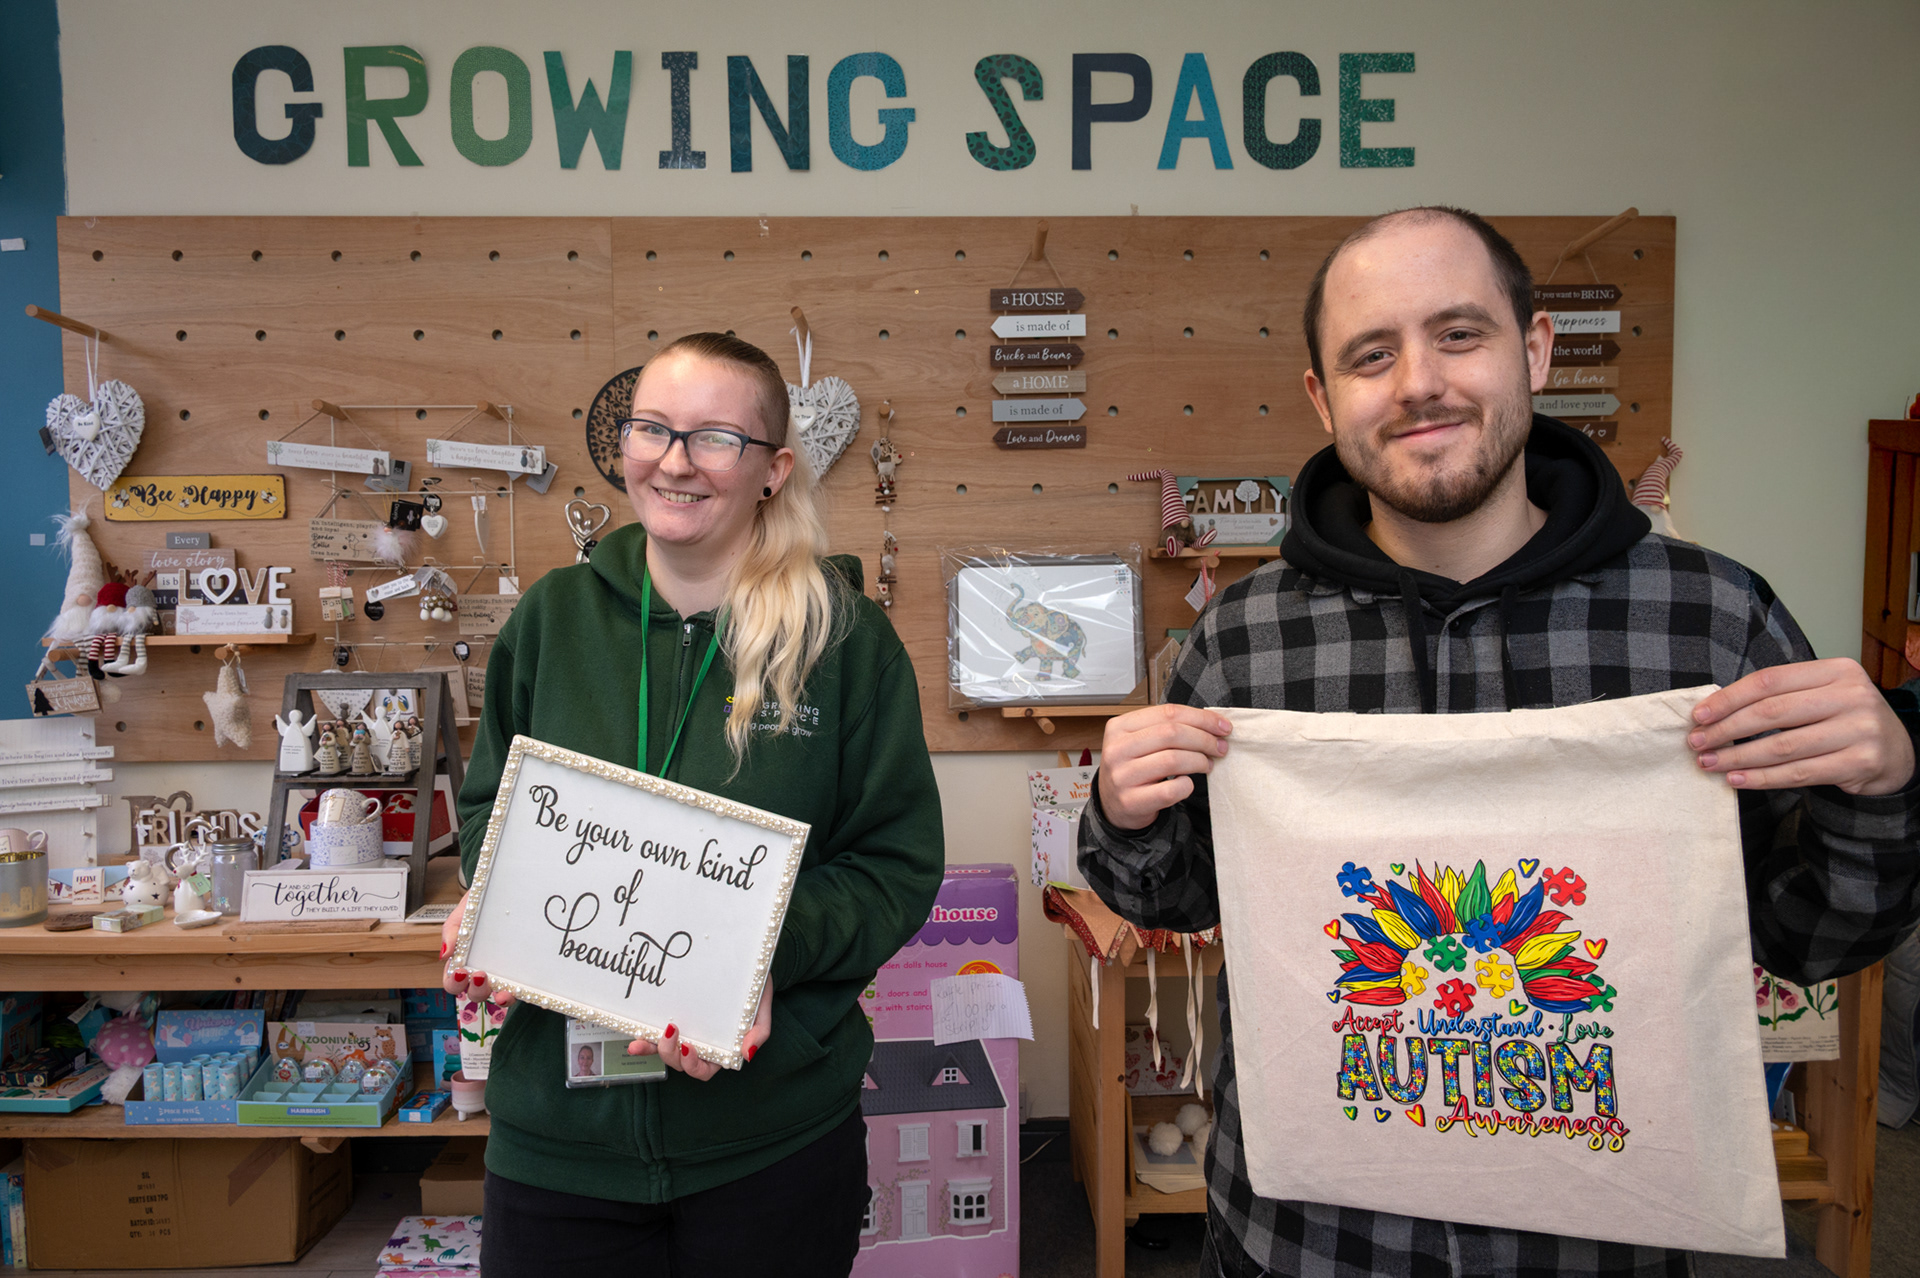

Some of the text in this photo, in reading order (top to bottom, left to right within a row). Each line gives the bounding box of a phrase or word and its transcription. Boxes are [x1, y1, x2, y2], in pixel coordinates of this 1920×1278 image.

[232, 44, 1416, 172] GROWING SPACE
[1002, 292, 1065, 306] a HOUSE
[1534, 291, 1541, 299] If
[1542, 293, 1555, 301] you
[1556, 291, 1572, 299] want
[1581, 290, 1614, 299] BRING
[1016, 320, 1070, 332] is made of
[995, 348, 1025, 361] Bricks
[1042, 347, 1072, 361] Beams
[1553, 345, 1602, 356] the world
[1013, 375, 1069, 389] a HOME
[1553, 369, 1606, 387] Go home
[1009, 404, 1063, 416] is made of
[1539, 399, 1607, 411] and love your
[1006, 429, 1081, 445] Love and Dreams
[129, 483, 258, 510] Bee Happy
[174, 536, 200, 546] Every
[311, 532, 335, 541] Border
[151, 550, 227, 570] love story
[162, 576, 171, 586] is
[792, 726, 812, 738] grow
[2, 778, 18, 786] lives
[529, 784, 768, 891] Be your own kind
[613, 869, 645, 927] of
[932, 905, 998, 922] house
[543, 892, 693, 999] beautiful
[904, 961, 922, 969] dolls
[925, 960, 948, 969] house
[887, 989, 910, 998] doors
[913, 988, 928, 997] and
[885, 1004, 904, 1012] with
[985, 1002, 996, 1018] for
[184, 1017, 237, 1031] Unicorn
[1332, 1004, 1614, 1044] Accept Understand Love
[305, 1036, 371, 1045] ZOONIVERSE
[1336, 1034, 1619, 1118] AUTISM
[1435, 1094, 1631, 1152] Awareness
[141, 1171, 150, 1179] SIL
[130, 1219, 147, 1227] BATCH
